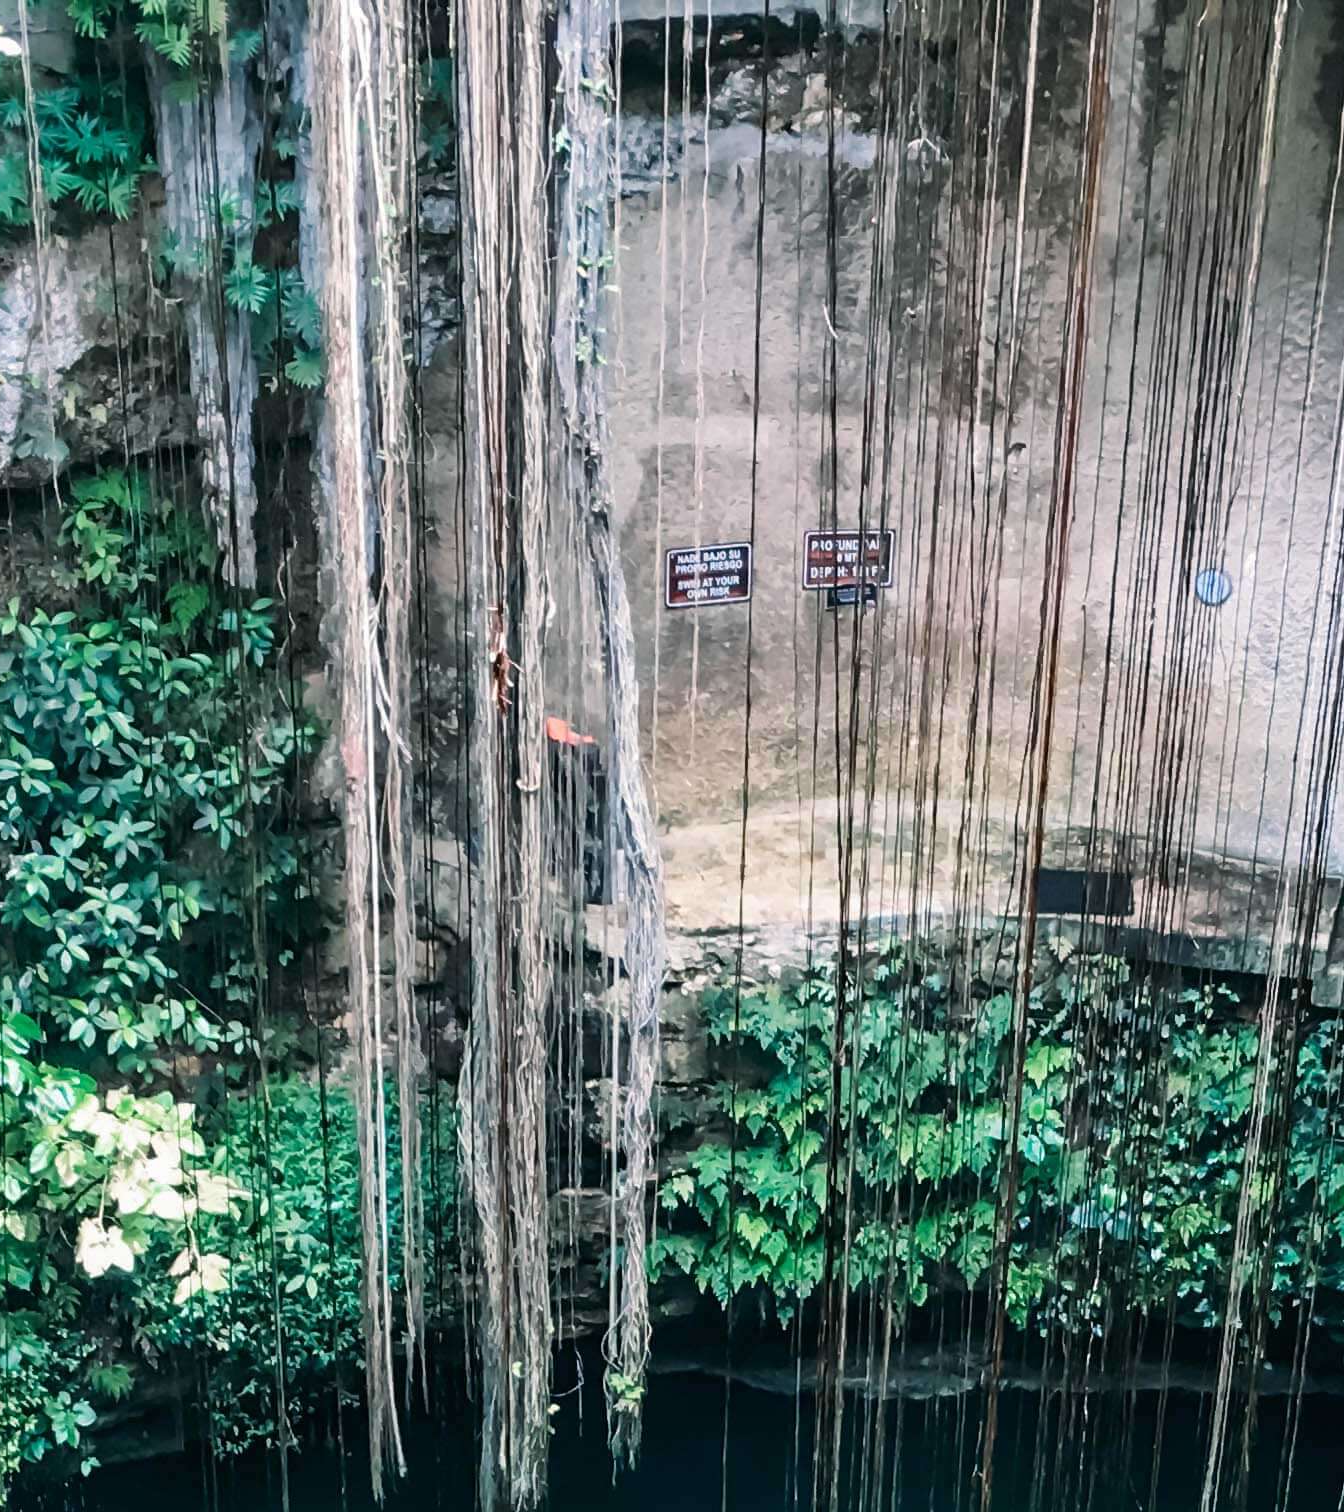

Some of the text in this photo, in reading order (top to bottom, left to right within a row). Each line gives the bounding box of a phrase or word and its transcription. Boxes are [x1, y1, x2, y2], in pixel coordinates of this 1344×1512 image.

[677, 549, 741, 564] NAD BAJO SU
[710, 560, 743, 571] RIESGO
[703, 577, 714, 588] AT
[715, 575, 740, 586] YOUR
[709, 586, 731, 597] RISK
